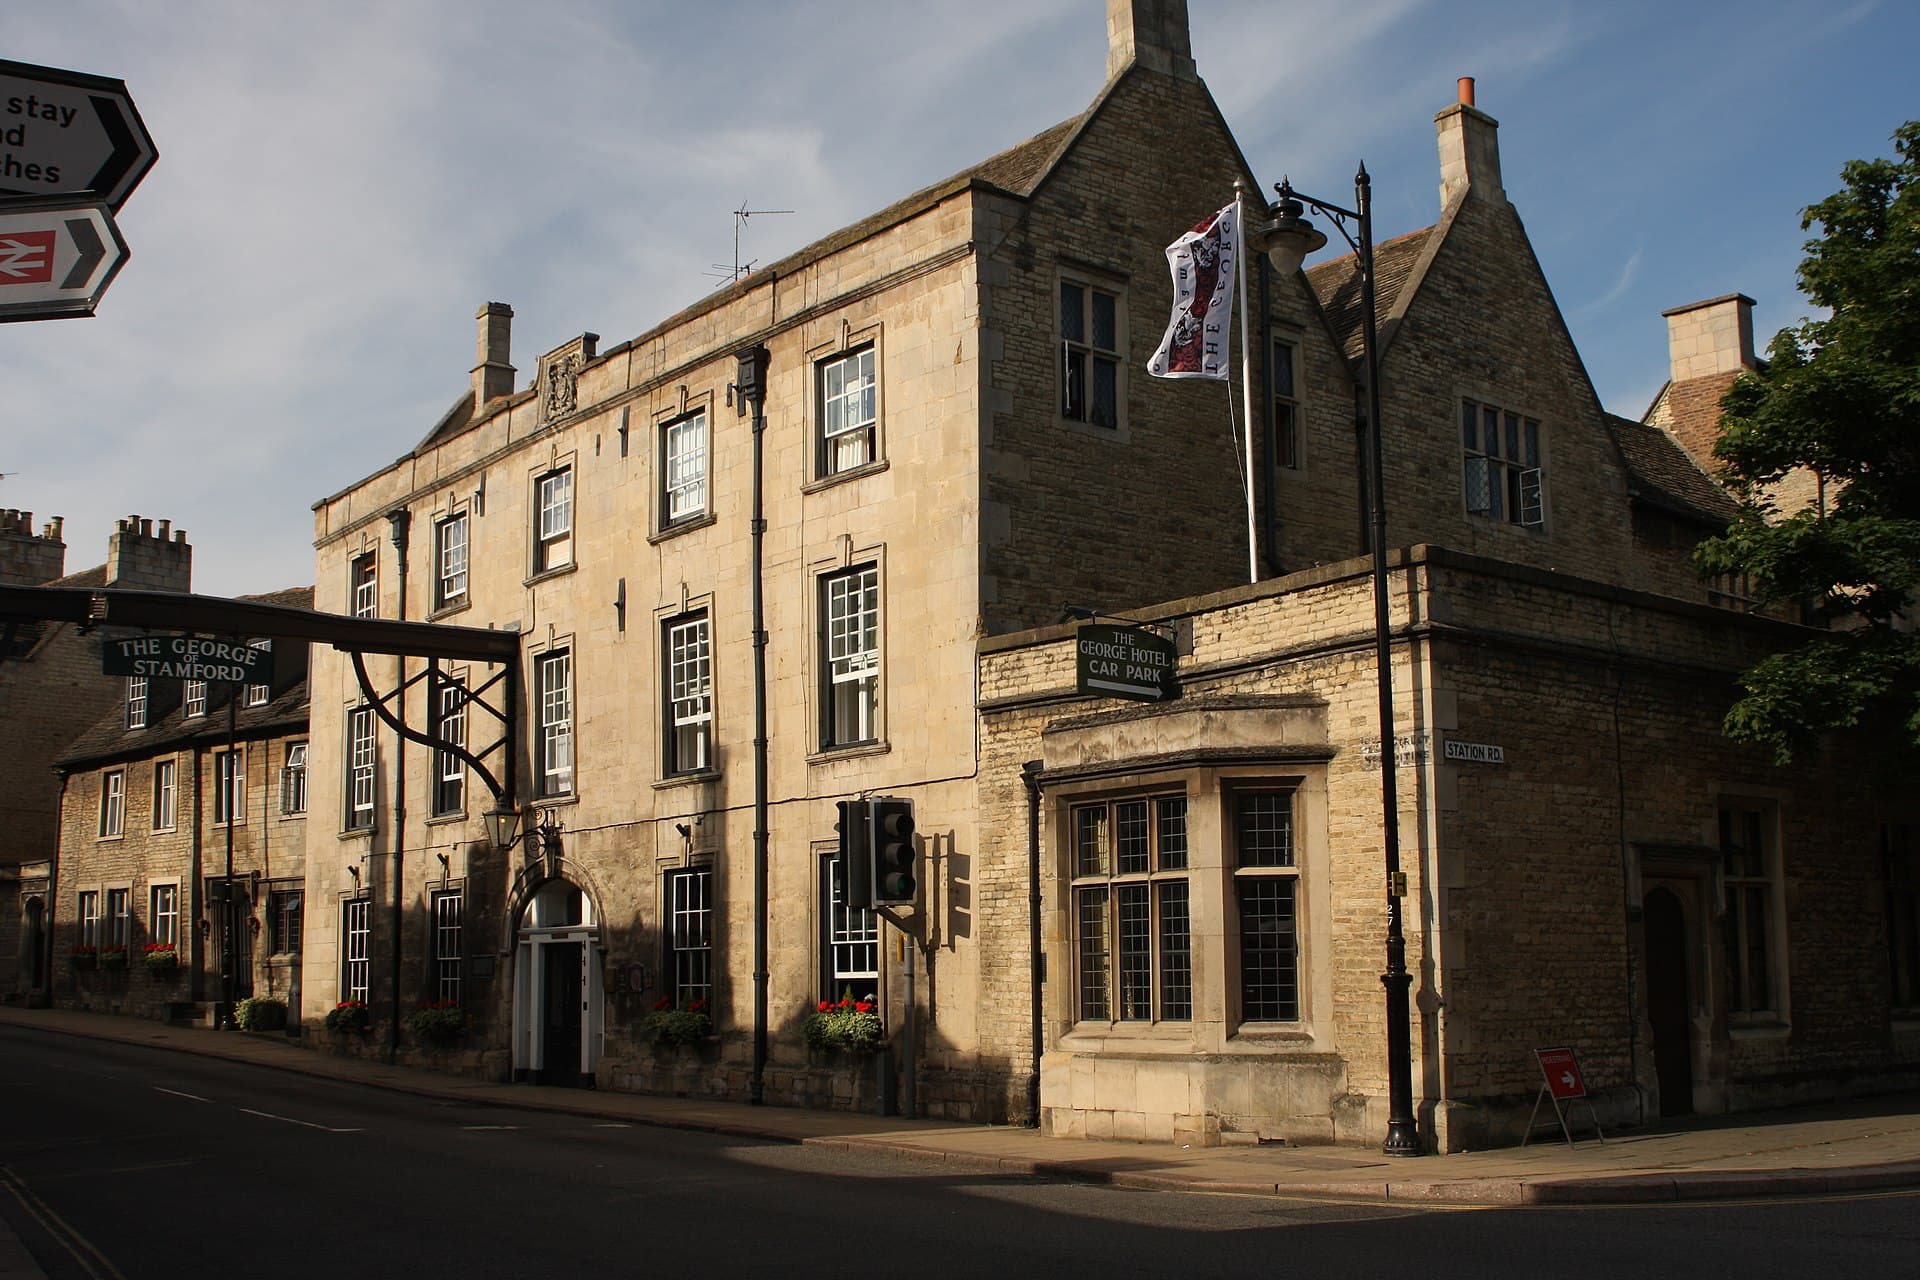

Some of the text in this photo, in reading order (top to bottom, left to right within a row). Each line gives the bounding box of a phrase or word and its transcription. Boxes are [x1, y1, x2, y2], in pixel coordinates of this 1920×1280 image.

[6, 95, 77, 128] stay
[0, 124, 25, 147] d
[0, 153, 60, 184] hes
[1113, 632, 1135, 646] THE
[117, 638, 258, 666] THE GEORGE
[183, 654, 200, 663] OF
[1080, 640, 1170, 667] GEORGE HOTEL
[134, 660, 245, 681] STAMFORD
[1089, 660, 1161, 682] CAR PARK
[1448, 743, 1503, 761] STATION RD.
